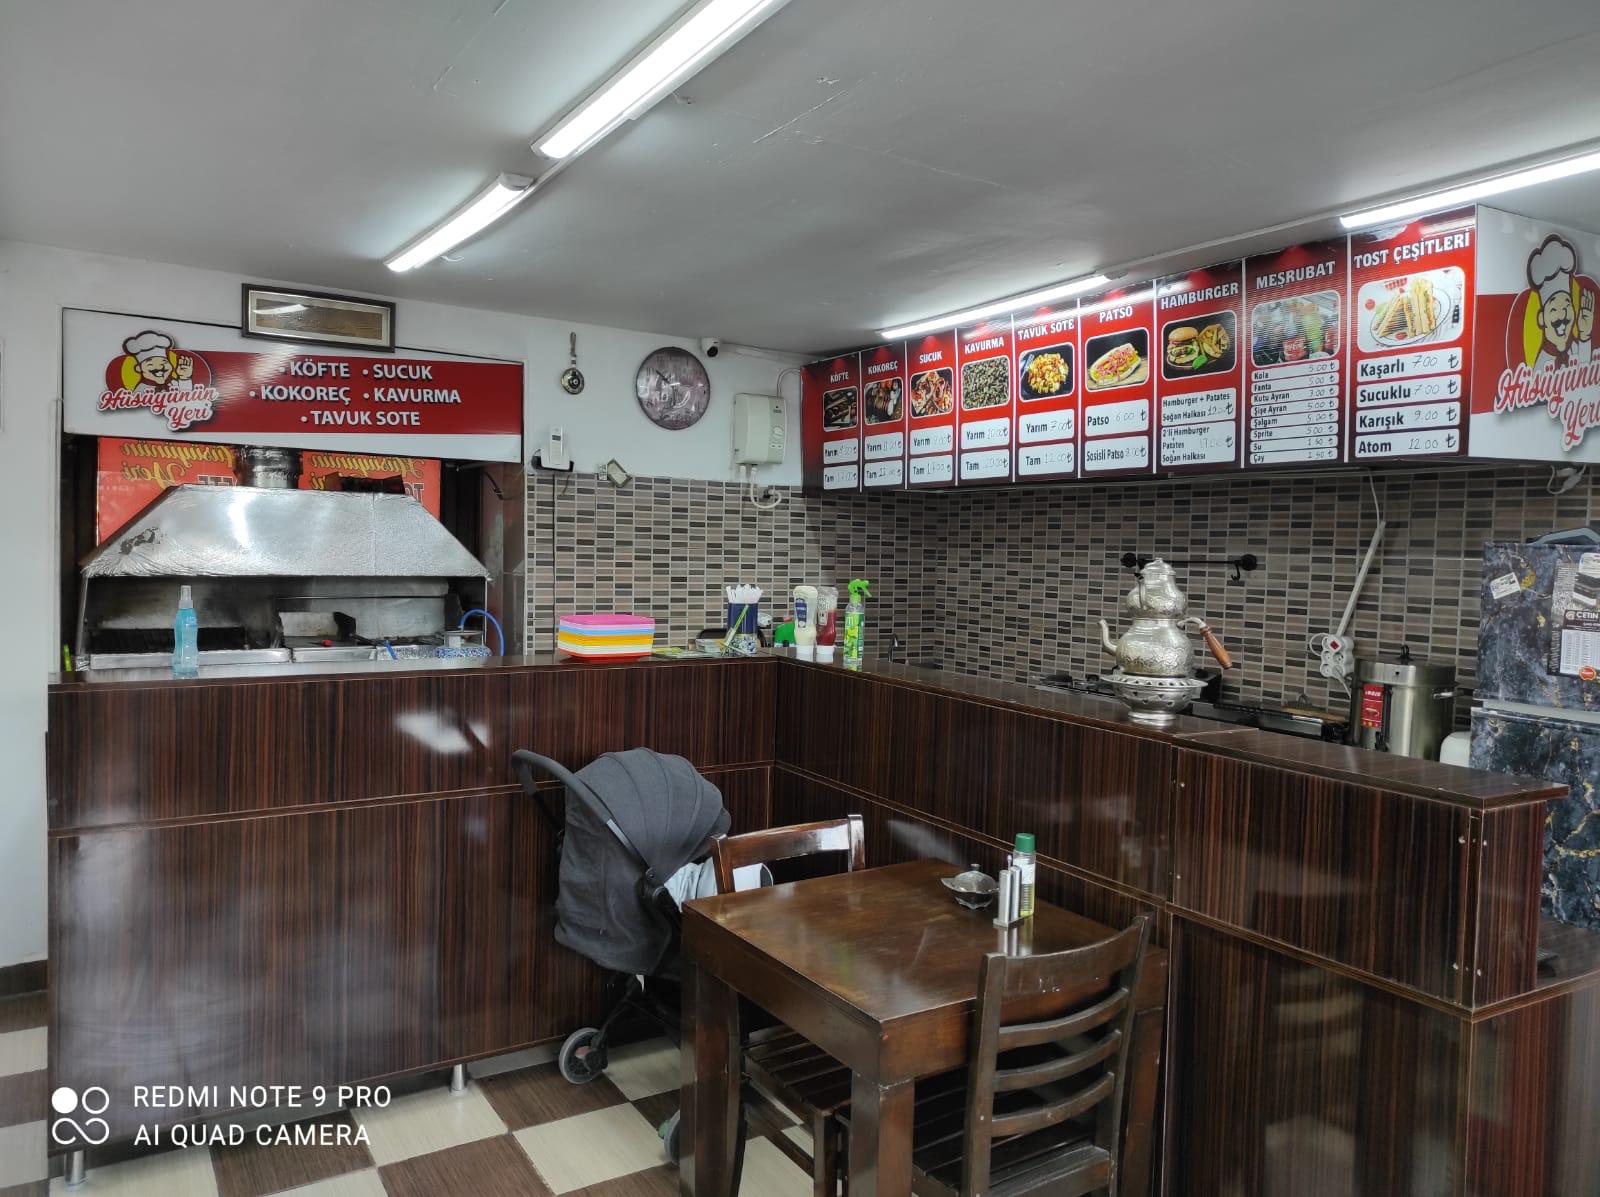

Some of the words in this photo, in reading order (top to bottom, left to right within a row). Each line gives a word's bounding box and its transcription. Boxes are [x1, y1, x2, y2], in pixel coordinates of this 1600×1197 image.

[1354, 249, 1389, 269] TOST
[1393, 231, 1470, 265] ÇEŞİTLERİ
[1161, 282, 1239, 310] HAMBURGER
[1099, 305, 1133, 323] PATSO
[1018, 326, 1048, 341] TAVUK
[1050, 319, 1075, 334] SOTE
[964, 337, 1005, 354] KAVURMA
[919, 351, 943, 364] SUCUK
[290, 358, 350, 378] KÖFTE
[373, 363, 433, 380] SUCUK
[868, 360, 899, 375] KOKOREÇ
[1360, 359, 1405, 379] Kaşarlı
[1254, 371, 1269, 380] Kola
[1254, 383, 1271, 391] Fanta
[1496, 353, 1600, 416] Hüsüyünü
[261, 384, 351, 405] KOKOREÇ
[373, 387, 462, 404] KAVURMA
[1163, 396, 1199, 407] Hamburger
[1206, 393, 1231, 402] Patates
[1271, 393, 1290, 402] Ayran
[1360, 385, 1411, 403] Sucuklu
[167, 402, 211, 430] Yeri
[1163, 413, 1182, 423] Soğan
[1183, 409, 1206, 419] Halkası
[1254, 406, 1267, 416] Şişe
[1268, 405, 1287, 414] Ayran
[311, 410, 373, 426] TAVUK
[376, 411, 421, 426] SOTE
[1087, 414, 1110, 427] Patso
[1254, 418, 1278, 428] Şalgam
[1359, 411, 1404, 432] Karışık
[1026, 422, 1048, 434] Yarım
[1174, 427, 1210, 437] Hamburger
[966, 430, 985, 441] Yarım
[1254, 431, 1273, 440] Sprite
[1162, 441, 1185, 450] Patates
[1253, 443, 1262, 451] Su
[1358, 440, 1392, 454] Atom
[1026, 455, 1041, 466] Tam
[1087, 448, 1106, 462] Sosisli
[1107, 448, 1124, 460] Patso
[1162, 454, 1181, 464] Soğan
[1182, 452, 1206, 461] Halkası
[1253, 454, 1265, 463] Çay
[913, 466, 925, 476] Tam
[966, 461, 979, 471] Tam
[866, 470, 877, 479] Tam
